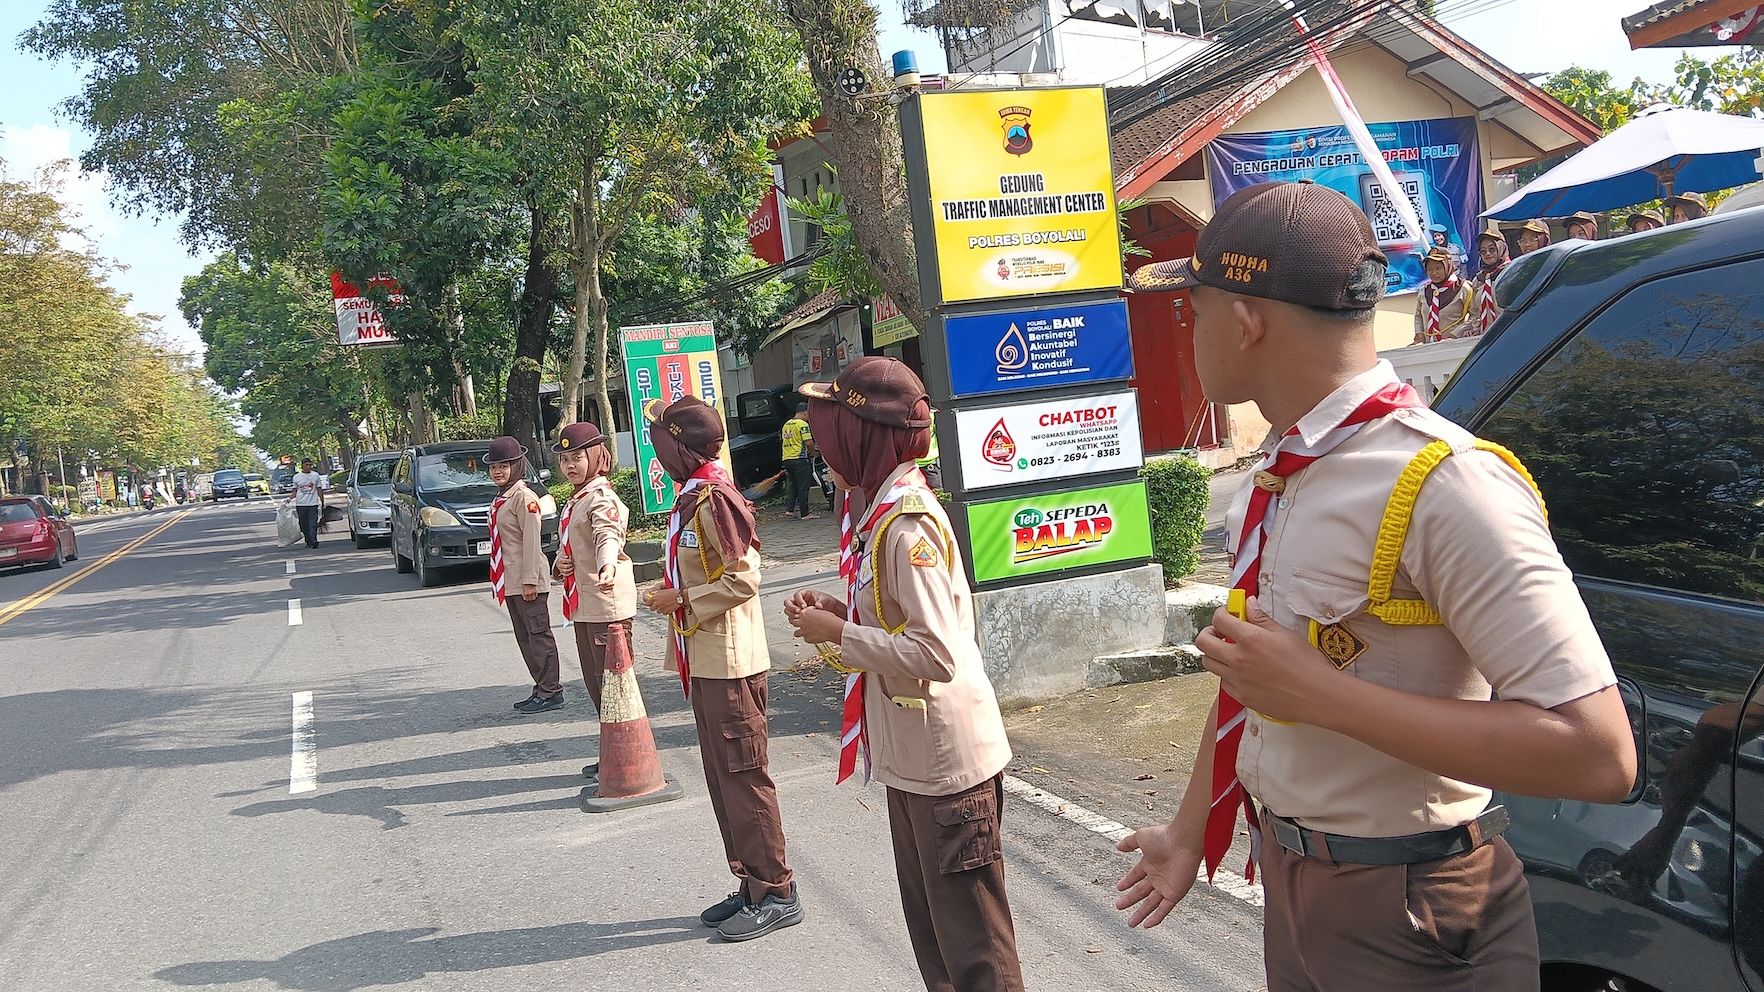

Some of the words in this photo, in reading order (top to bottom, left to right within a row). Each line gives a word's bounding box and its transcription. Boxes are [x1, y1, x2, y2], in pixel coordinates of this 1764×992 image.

[1319, 153, 1360, 169] CEPAT
[1364, 147, 1419, 163] OPAM
[1421, 144, 1459, 159] POLRI
[1000, 174, 1044, 194] GEDUNG
[943, 200, 987, 220] TRAFFIC
[988, 196, 1062, 218] MANAGEMENT
[1065, 193, 1105, 213] CENTER
[969, 233, 1020, 249] POLRES
[1023, 229, 1086, 245] BOYOLALI
[1224, 267, 1252, 283] A36
[357, 311, 383, 324] HA
[1053, 316, 1085, 329] BAIK
[624, 327, 668, 341] MANDIRI
[669, 324, 712, 338] SENTOSA
[1028, 328, 1076, 341] Bersinergi
[1030, 338, 1077, 351] Akuntabel
[1031, 349, 1066, 360] Inovatif
[1032, 358, 1073, 370] Kondusif
[668, 363, 685, 404] TUKA
[848, 389, 866, 405] LISA
[1039, 406, 1117, 427] CHATBOT
[1079, 419, 1118, 428] WHATSAPP
[1031, 431, 1066, 440] INFORMASI
[1066, 427, 1103, 436] KEPOLISIAN
[1046, 438, 1076, 447] LAPORAN
[1077, 433, 1119, 443] MASYARAKAT
[1076, 442, 1098, 451] KETIK
[1030, 456, 1055, 466] 0823
[1063, 452, 1088, 462] 2694
[1097, 448, 1121, 458] 8383
[649, 458, 665, 504] AKI
[1017, 513, 1042, 525] Teh
[1045, 503, 1108, 522] SEPEDA
[1012, 516, 1112, 554] BALAP
